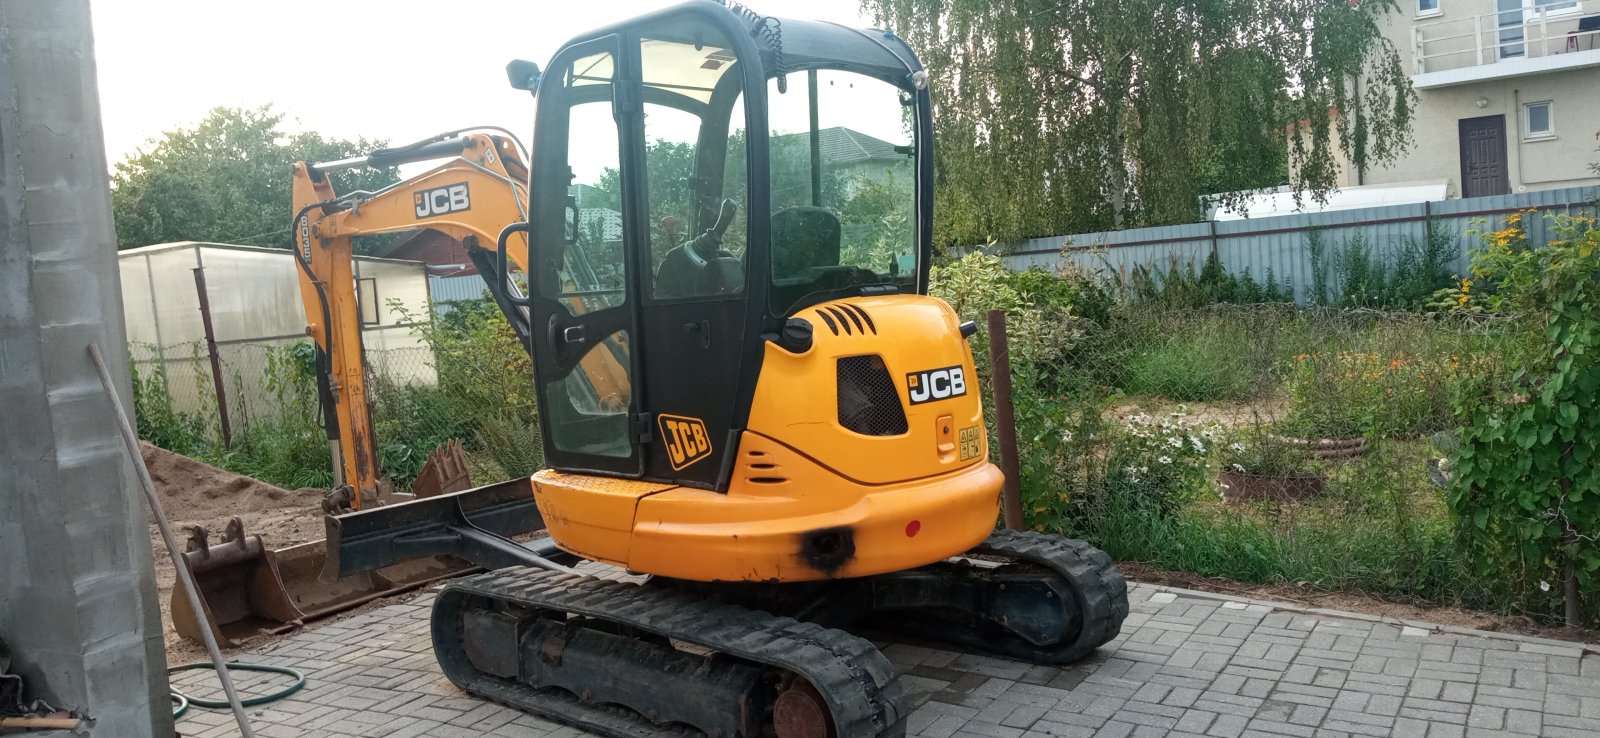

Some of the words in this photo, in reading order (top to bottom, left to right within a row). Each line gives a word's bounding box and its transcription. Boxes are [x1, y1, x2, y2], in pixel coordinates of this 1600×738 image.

[415, 185, 469, 217] JCB
[910, 368, 966, 402] JCB
[665, 420, 708, 464] JCB
